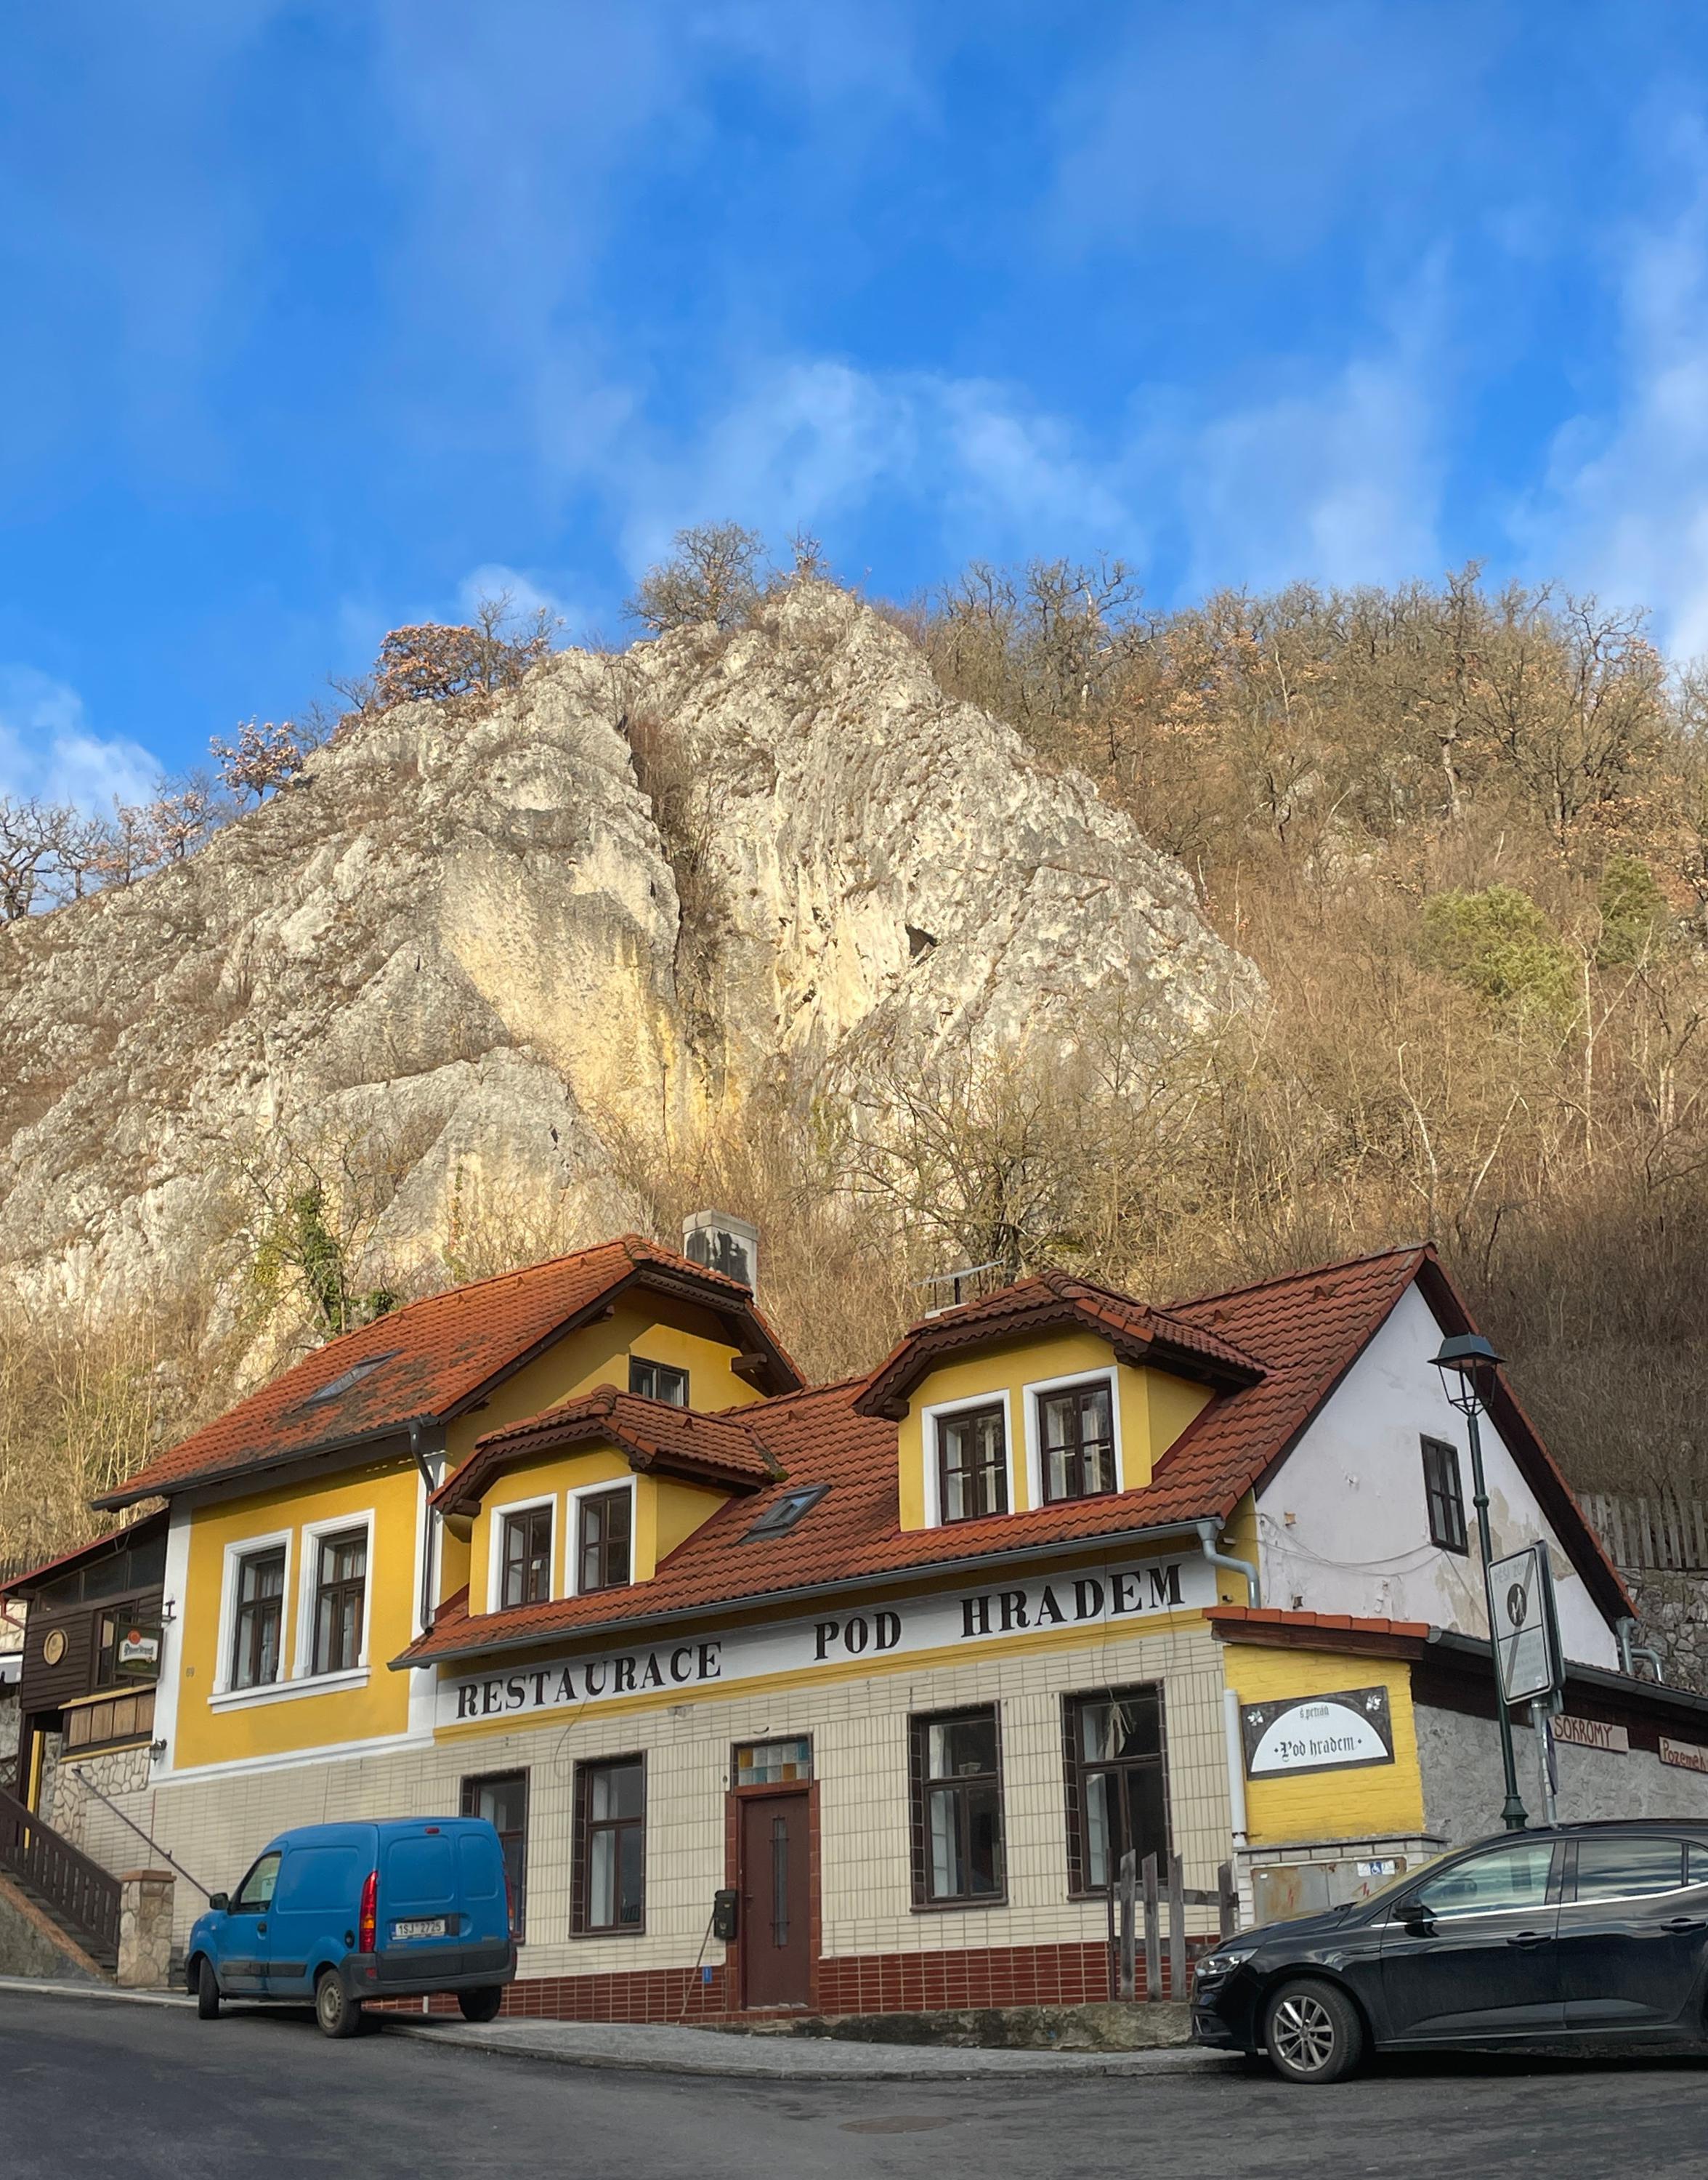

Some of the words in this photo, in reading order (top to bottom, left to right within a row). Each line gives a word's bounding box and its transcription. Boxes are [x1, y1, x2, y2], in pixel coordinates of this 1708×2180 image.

[457, 1642, 721, 1719] RESTAURACE
[814, 1611, 902, 1660] POD
[960, 1563, 1186, 1638] HRADEM
[1280, 1741, 1306, 1762] Pod
[1310, 1736, 1354, 1757] hradem
[399, 1924, 416, 1935] 1SJ
[421, 1921, 442, 1933] 2725
